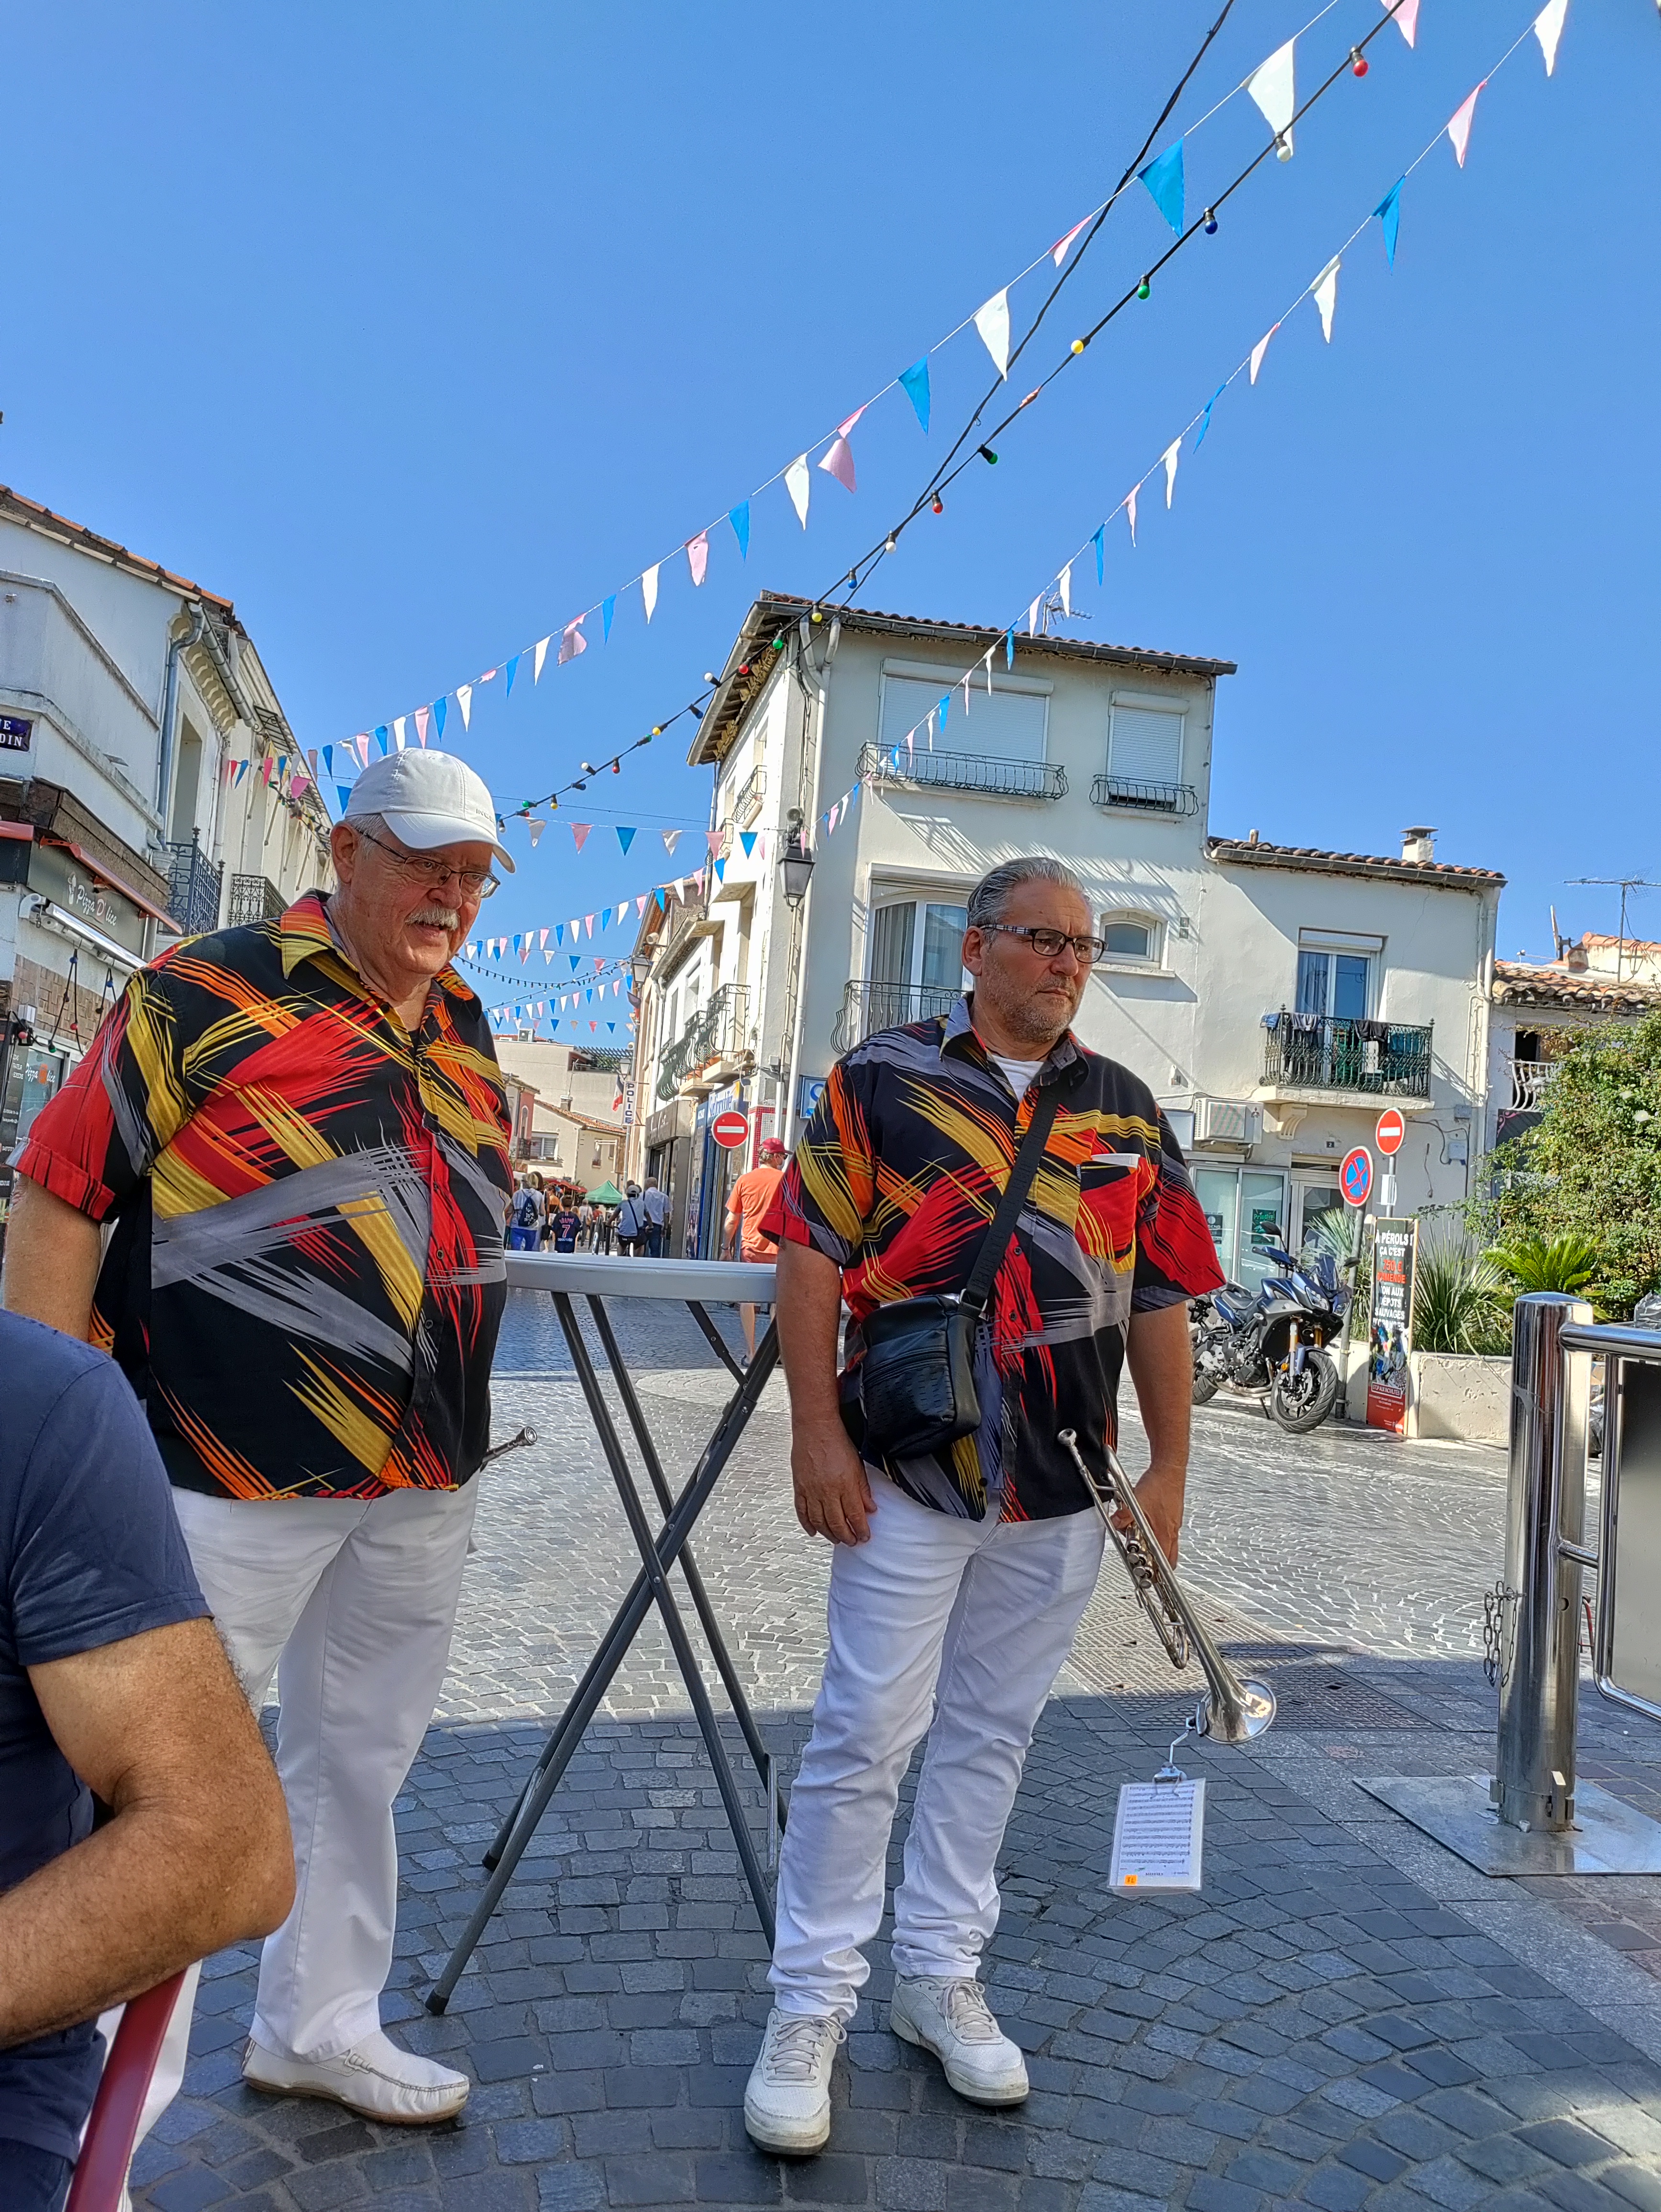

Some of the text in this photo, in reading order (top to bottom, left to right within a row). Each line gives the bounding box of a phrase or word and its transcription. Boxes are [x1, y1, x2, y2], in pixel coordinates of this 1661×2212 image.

[0, 718, 11, 730] E
[77, 885, 95, 915] Pizza
[625, 1083, 634, 1123] POLICE
[562, 1224, 570, 1238] 7
[1375, 1229, 1413, 1246] À PÉROLS !
[1380, 1246, 1406, 1257] ÇA C'EST
[1383, 1259, 1403, 1272] 750 €
[1380, 1285, 1404, 1297] ON AUX
[1374, 1306, 1405, 1320] SAUVAGES
